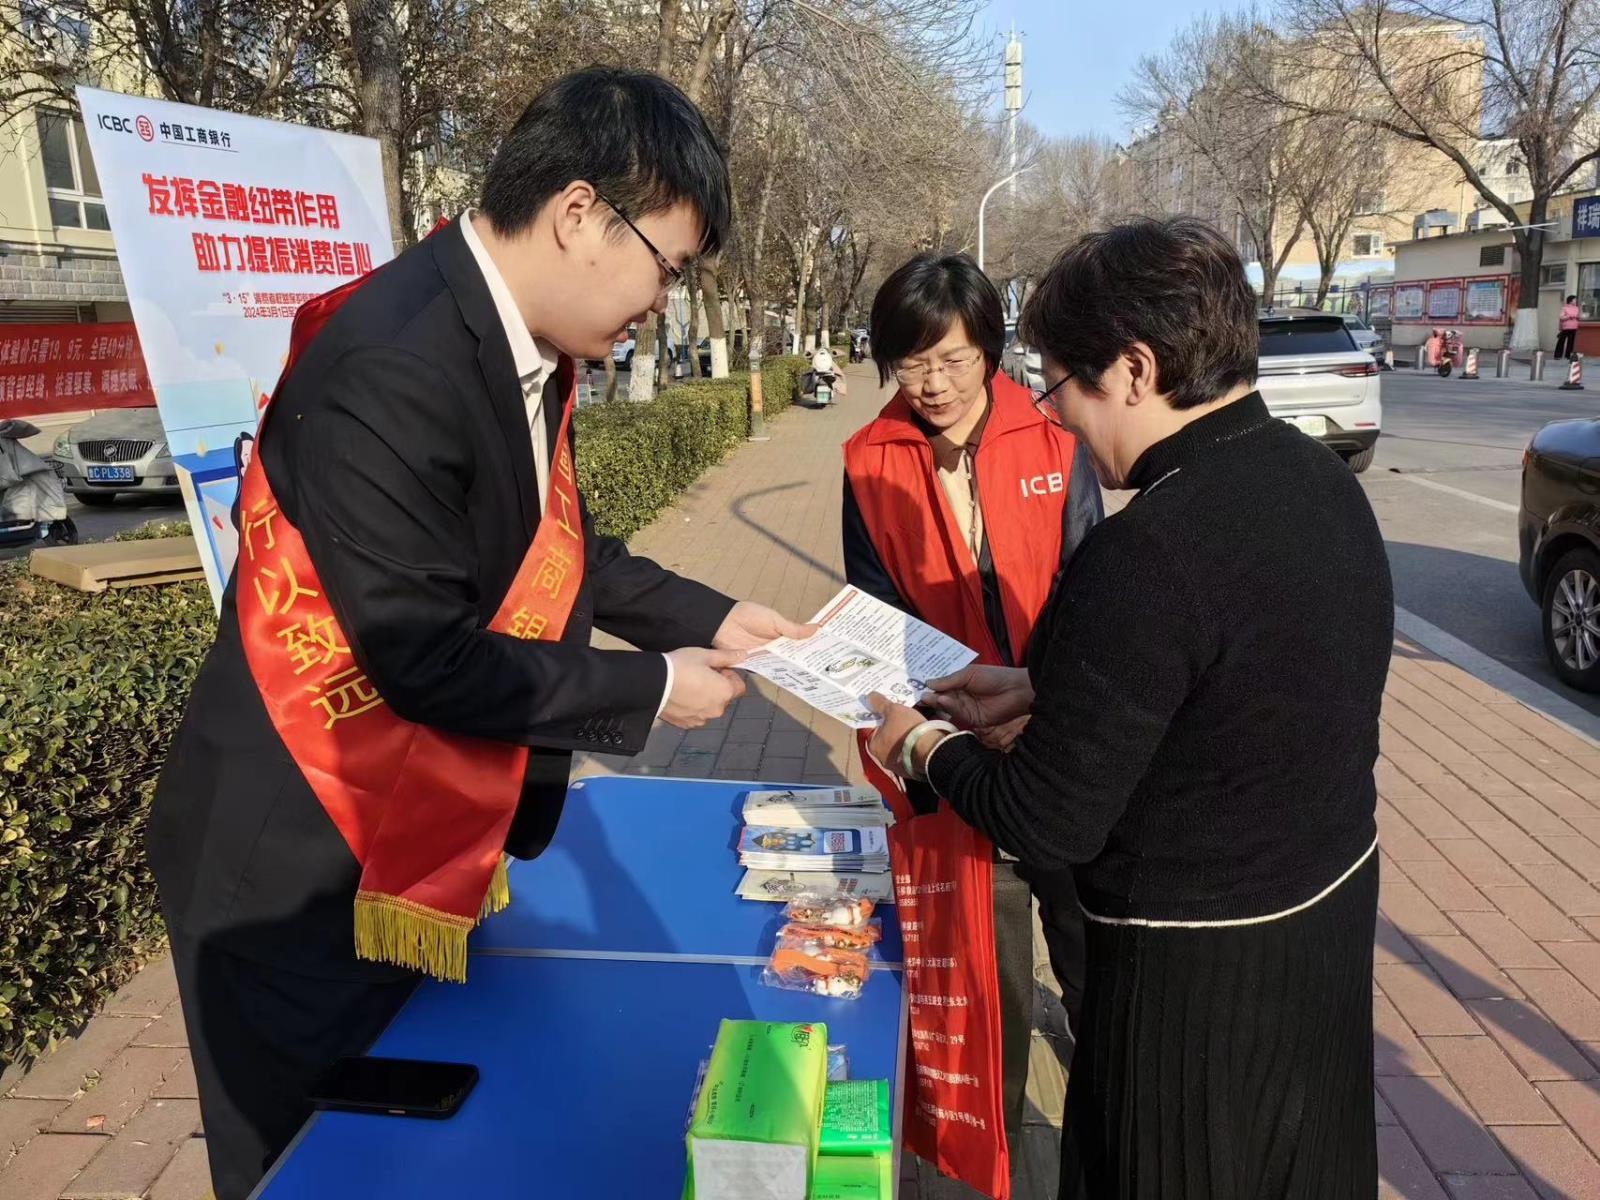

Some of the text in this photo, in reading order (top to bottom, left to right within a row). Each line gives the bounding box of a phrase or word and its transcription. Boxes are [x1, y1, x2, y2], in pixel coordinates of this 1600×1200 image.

[97, 113, 133, 134] ICBC
[159, 121, 232, 148] 中国工商银行
[142, 172, 341, 230] 发挥金融纽带作用
[1577, 202, 1600, 231] 祥瑞
[191, 231, 374, 276] 助力提振消费信心
[243, 306, 300, 319] 2024年3月1日至
[1020, 471, 1063, 498] ICB
[241, 498, 385, 730] 行以致远
